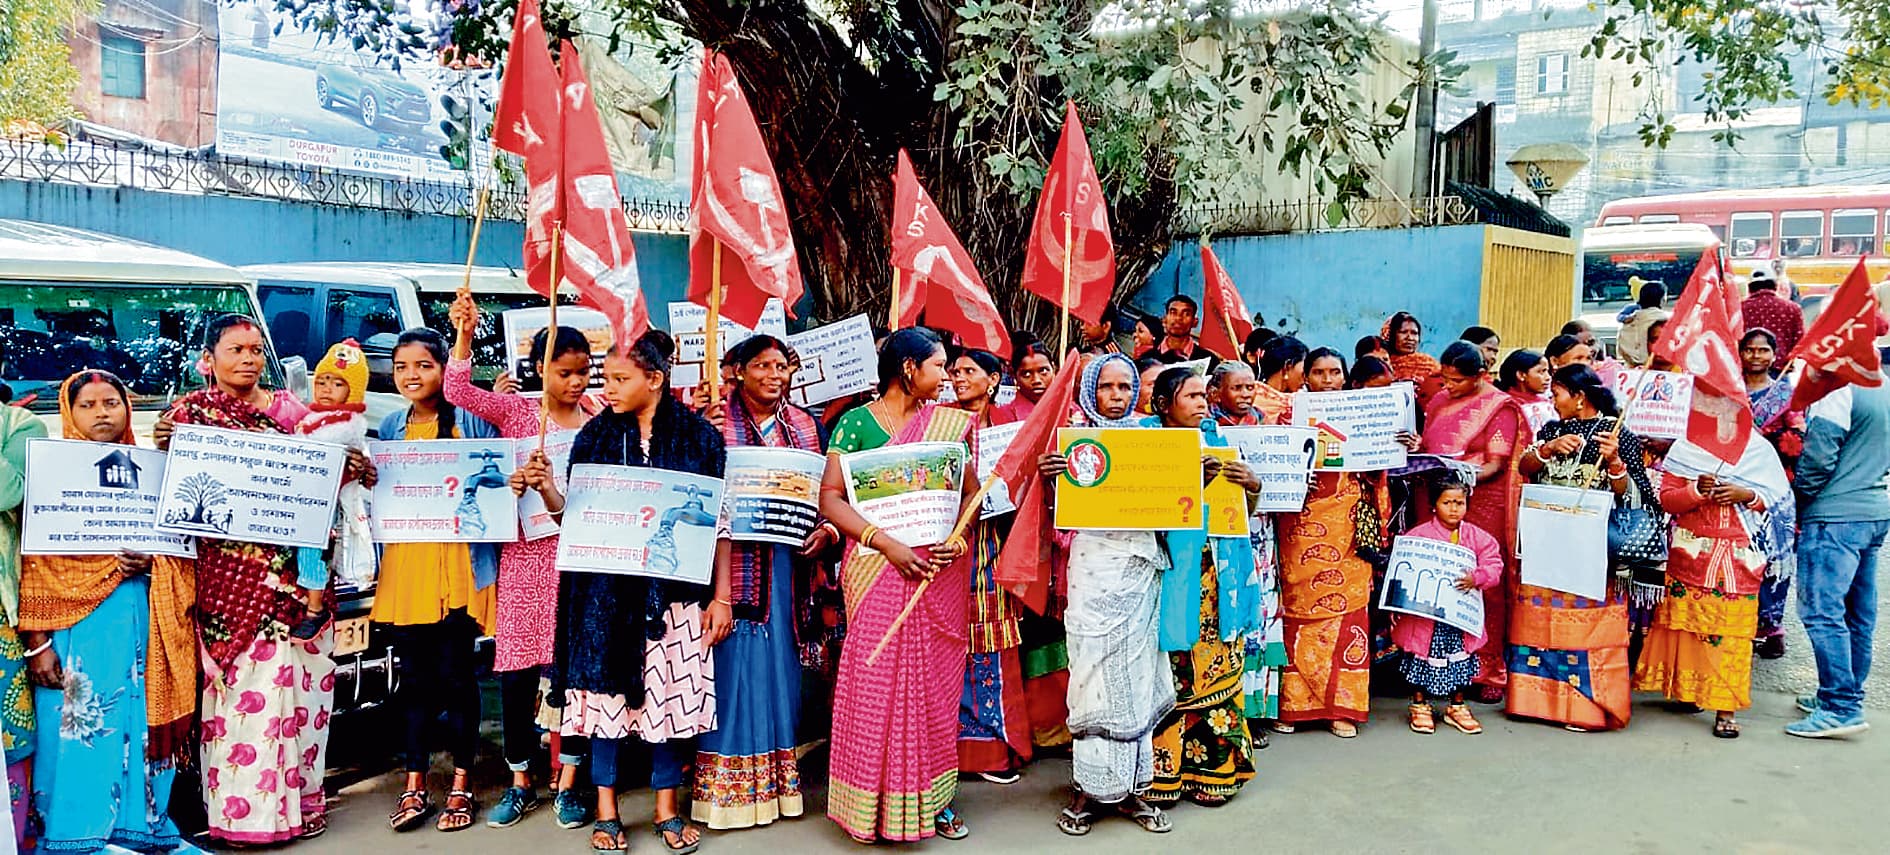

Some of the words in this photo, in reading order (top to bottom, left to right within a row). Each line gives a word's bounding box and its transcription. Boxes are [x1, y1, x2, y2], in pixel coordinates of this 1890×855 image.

[289, 139, 338, 153] DURGAPUR
[296, 152, 330, 164] TOYOTA
[684, 338, 705, 346] WARD
[805, 362, 815, 370] NO
[227, 488, 280, 502] আসানসোল
